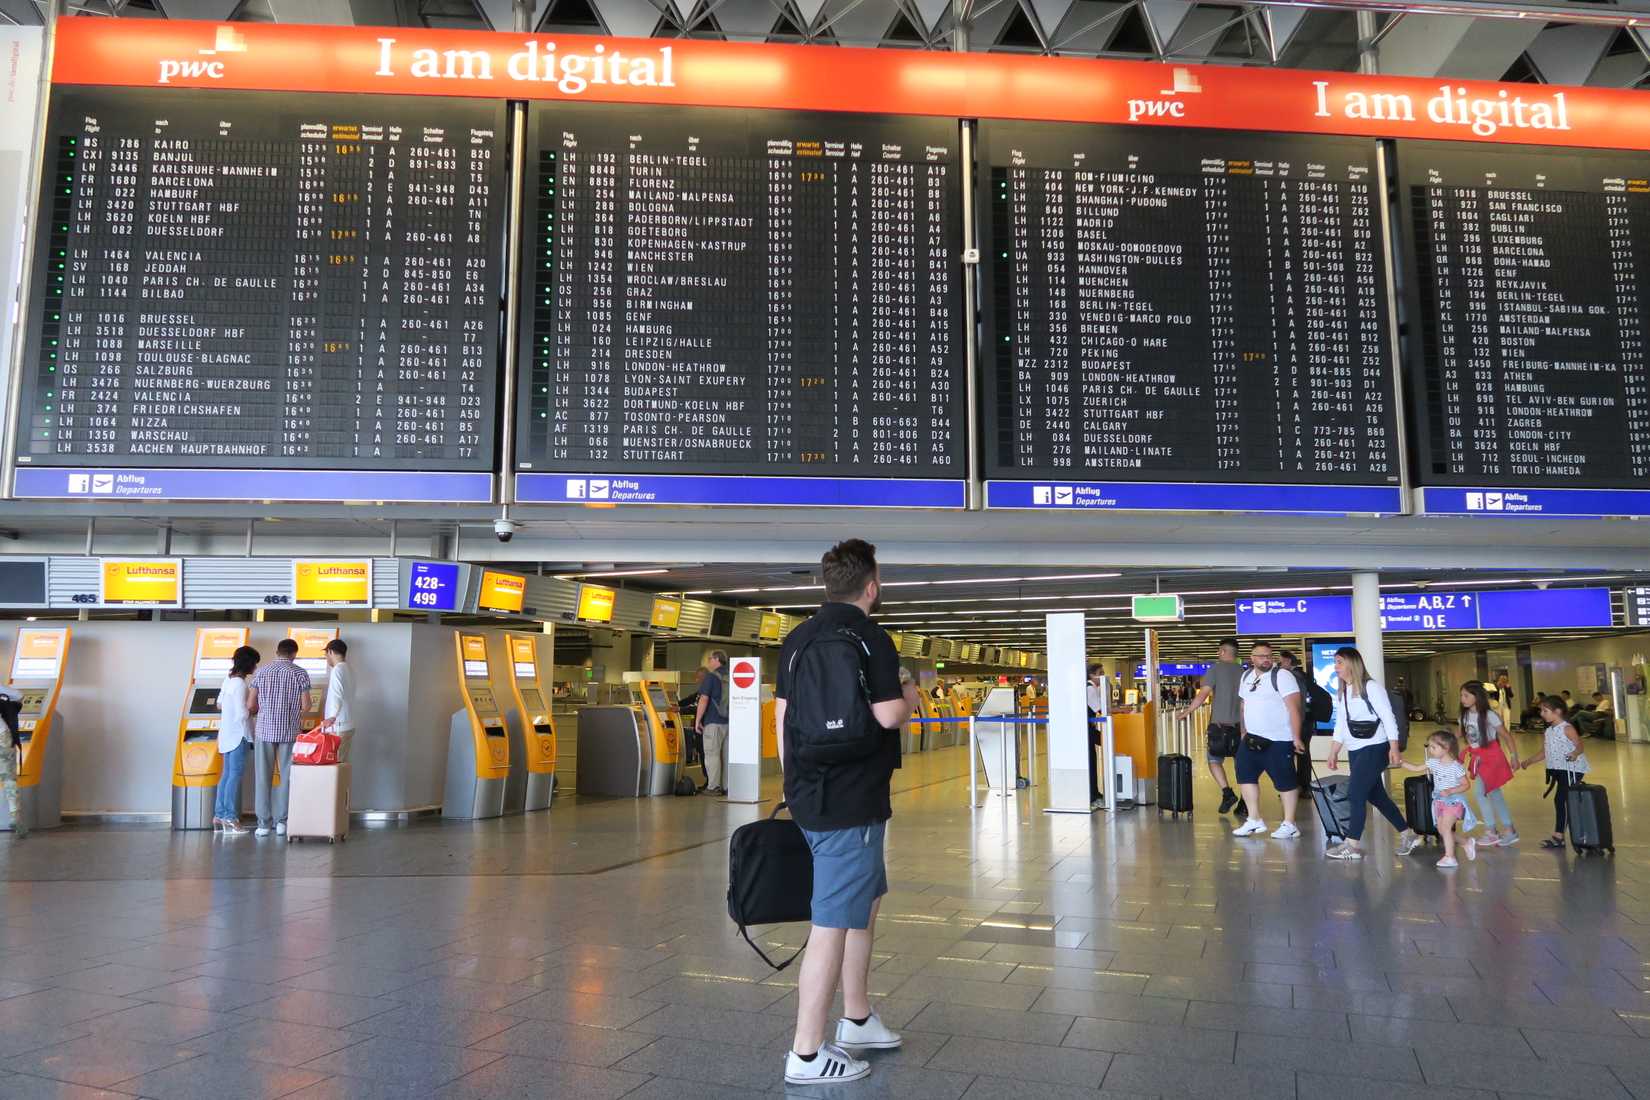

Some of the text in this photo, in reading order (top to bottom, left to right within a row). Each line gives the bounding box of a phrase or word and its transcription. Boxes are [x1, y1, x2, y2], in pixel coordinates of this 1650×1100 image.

[157, 60, 225, 83] pwc
[376, 39, 674, 94] I am digital
[1128, 100, 1185, 121] pwc
[1313, 82, 1570, 136] I am digital
[154, 139, 189, 150] KAIRO
[153, 151, 194, 162] BANJUL
[629, 154, 707, 167] BERLIN-TEGEL
[152, 164, 278, 177] KARLSRUHE-MANNHEIM
[629, 166, 662, 177] TURIN
[151, 176, 214, 187] BARCELONA
[1074, 171, 1154, 184] ROM-FIUMICINO
[629, 178, 675, 189] FLORENZ
[1075, 183, 1094, 193] NEW
[628, 190, 734, 203] MAILAND-MALPENSA
[1076, 194, 1168, 208] SHANGHAI-PUDONG
[1487, 190, 1532, 201] BRUESSEL
[149, 200, 240, 213] STUTTGART HBF
[628, 201, 674, 213] BOLOGNA
[1488, 201, 1506, 210] SAN
[1076, 206, 1119, 217] BILLUND
[148, 213, 211, 224] KOELN HBF
[628, 213, 753, 228] PADERBORN/LIPPSTADT
[1076, 218, 1114, 229] MADRID
[147, 225, 224, 237] DUESSELDORF
[628, 226, 688, 238] GOETEBORG
[1077, 229, 1107, 240] BASEL
[627, 238, 746, 252] KOPENHAGEN-KASTRUP
[627, 250, 694, 262] MANCHESTER
[1492, 246, 1544, 257] BARCELONA
[74, 249, 486, 268] LH 1464 VALENCIA 260-461 A20
[1077, 253, 1183, 266] WASHINGTON-DULLES
[144, 263, 187, 273] JEDDAH
[626, 262, 654, 273] WIEN
[1078, 264, 1128, 275] HANNOVER
[143, 275, 178, 286] PARIS
[214, 277, 227, 287] DE
[235, 278, 277, 288] GAULLE
[626, 275, 727, 287] WROCLAW/BRESLAU
[1078, 276, 1128, 287] MUENCHEN
[1496, 279, 1547, 290] REYKJAVIK
[142, 288, 184, 299] BILBAO
[626, 287, 652, 297] GRAZ
[1078, 288, 1135, 299] NUERNBERG
[626, 299, 693, 311] BIRMINGHAM
[1079, 299, 1153, 312] BERLIN-TEGEL
[140, 314, 195, 325] BRUESSEL
[625, 311, 652, 322] GENF
[1080, 312, 1192, 325] VENEDIG-MARCO POLO
[139, 326, 245, 338] DUESSELDORF HBF
[625, 324, 672, 335] HAMBURG
[1080, 324, 1118, 334] BREMEN
[138, 339, 201, 350] MARSEILLE
[625, 336, 712, 348] LEIPZIG/HALLE
[1143, 338, 1168, 348] HARE
[1500, 336, 1535, 347] BOSTON
[137, 352, 251, 364] TOULOUSE-BLAGNAC
[624, 348, 672, 360] DRESDEN
[1081, 348, 1118, 359] PEKING
[624, 361, 726, 373] LONDON-HEATHROW
[1018, 358, 1131, 370] WZZ 2312 BUDAPEST
[136, 365, 193, 376] SALZBURG
[624, 374, 746, 386] LYON-SAINT EXUPERY
[1082, 372, 1176, 384] LONDON-HEATHROW
[134, 378, 271, 390] NUERNBERG-WUERZBURG
[624, 386, 678, 397] BUDAPEST
[1082, 384, 1114, 394] PARIS
[1145, 385, 1157, 396] DE
[1163, 386, 1200, 396] GAULLE
[134, 391, 191, 402] VALENCIA
[1083, 396, 1127, 407] ZUERICH
[133, 404, 241, 415] FRIEDRICHSHAFEN
[623, 399, 745, 411] DORTMUND-KOELN HBF
[1083, 408, 1164, 420] STUTTGART HBF
[1506, 406, 1592, 417] LONDON-HEATHROW
[131, 417, 168, 428] NIZZA
[1083, 421, 1128, 431] CALGARY
[1507, 418, 1542, 428] ZAGREB
[130, 430, 188, 441] WARSCHAU
[554, 423, 567, 433] AF
[584, 424, 609, 434] 1319
[623, 424, 657, 435] PARIS
[691, 425, 704, 436] DE
[712, 426, 751, 437] GAULLE
[872, 428, 918, 440] 801-806
[1508, 430, 1571, 440] LONDON-CITY
[623, 437, 752, 449] MUENSTER/OSNABRUECK
[1083, 433, 1153, 444] DUESSELDORF
[130, 443, 266, 455] AACHEN HAUPTBAHNHOF
[1084, 445, 1172, 456] MAILAND-LINATE
[1509, 442, 1560, 452] KOELN HBF
[623, 449, 684, 460] STUTTGART
[1510, 453, 1586, 464] SEOUL-INCHEON
[1084, 458, 1142, 468] AMSTERDAM
[1512, 465, 1581, 475] TOKIO-HANEDA
[117, 475, 145, 485] Abflug
[612, 480, 639, 491] Abflug
[116, 486, 162, 495] Departures
[611, 490, 656, 501] Departures
[1075, 487, 1101, 497] Abflug
[1076, 497, 1116, 506] Departures
[126, 567, 175, 575] Lufthansa
[318, 568, 366, 576] Lufthansa
[72, 594, 97, 604] 465
[264, 595, 288, 605] 464
[414, 592, 437, 605] 499
[1297, 600, 1307, 613] C
[1423, 615, 1446, 629] D,E
